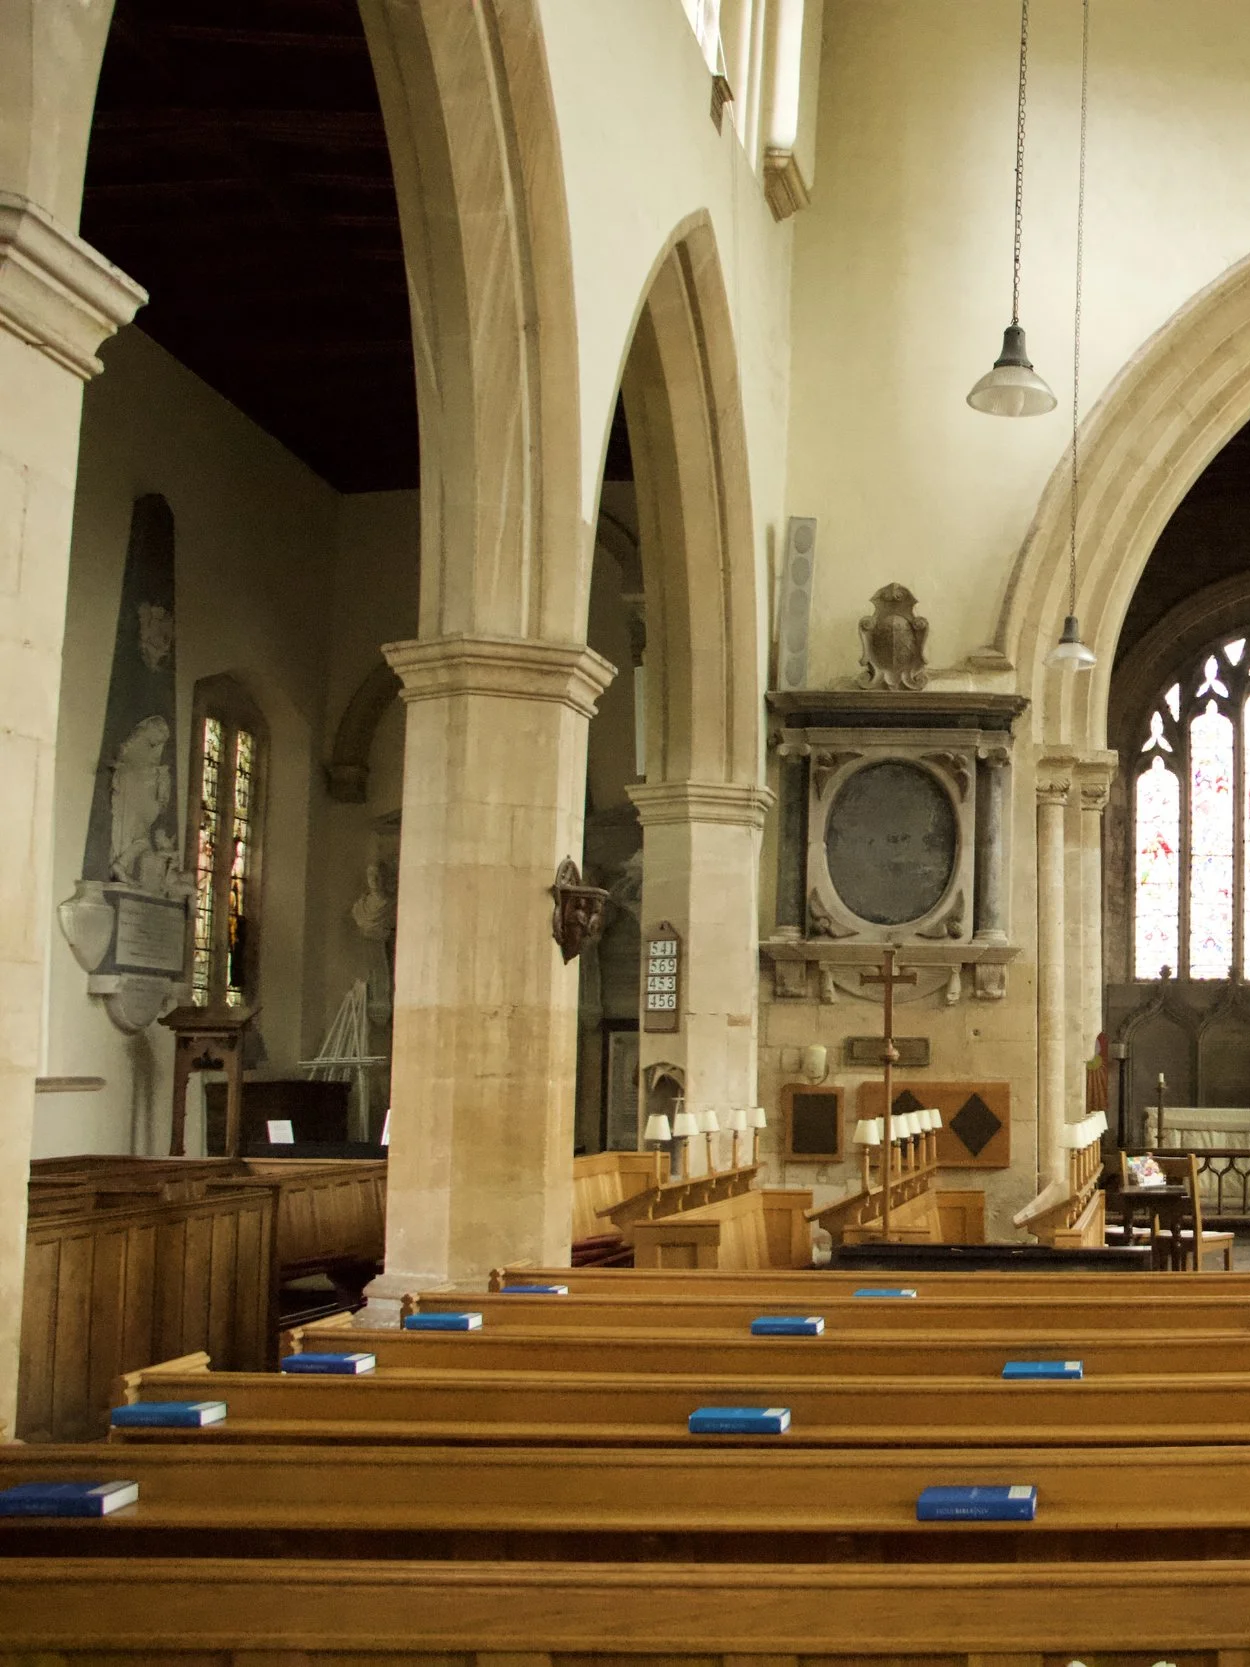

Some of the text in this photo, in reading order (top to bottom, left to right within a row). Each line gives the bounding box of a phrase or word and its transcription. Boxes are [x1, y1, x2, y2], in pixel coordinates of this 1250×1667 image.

[651, 942, 675, 955] 541
[650, 959, 675, 972] 569
[649, 977, 675, 990] 453
[650, 995, 675, 1008] 456
